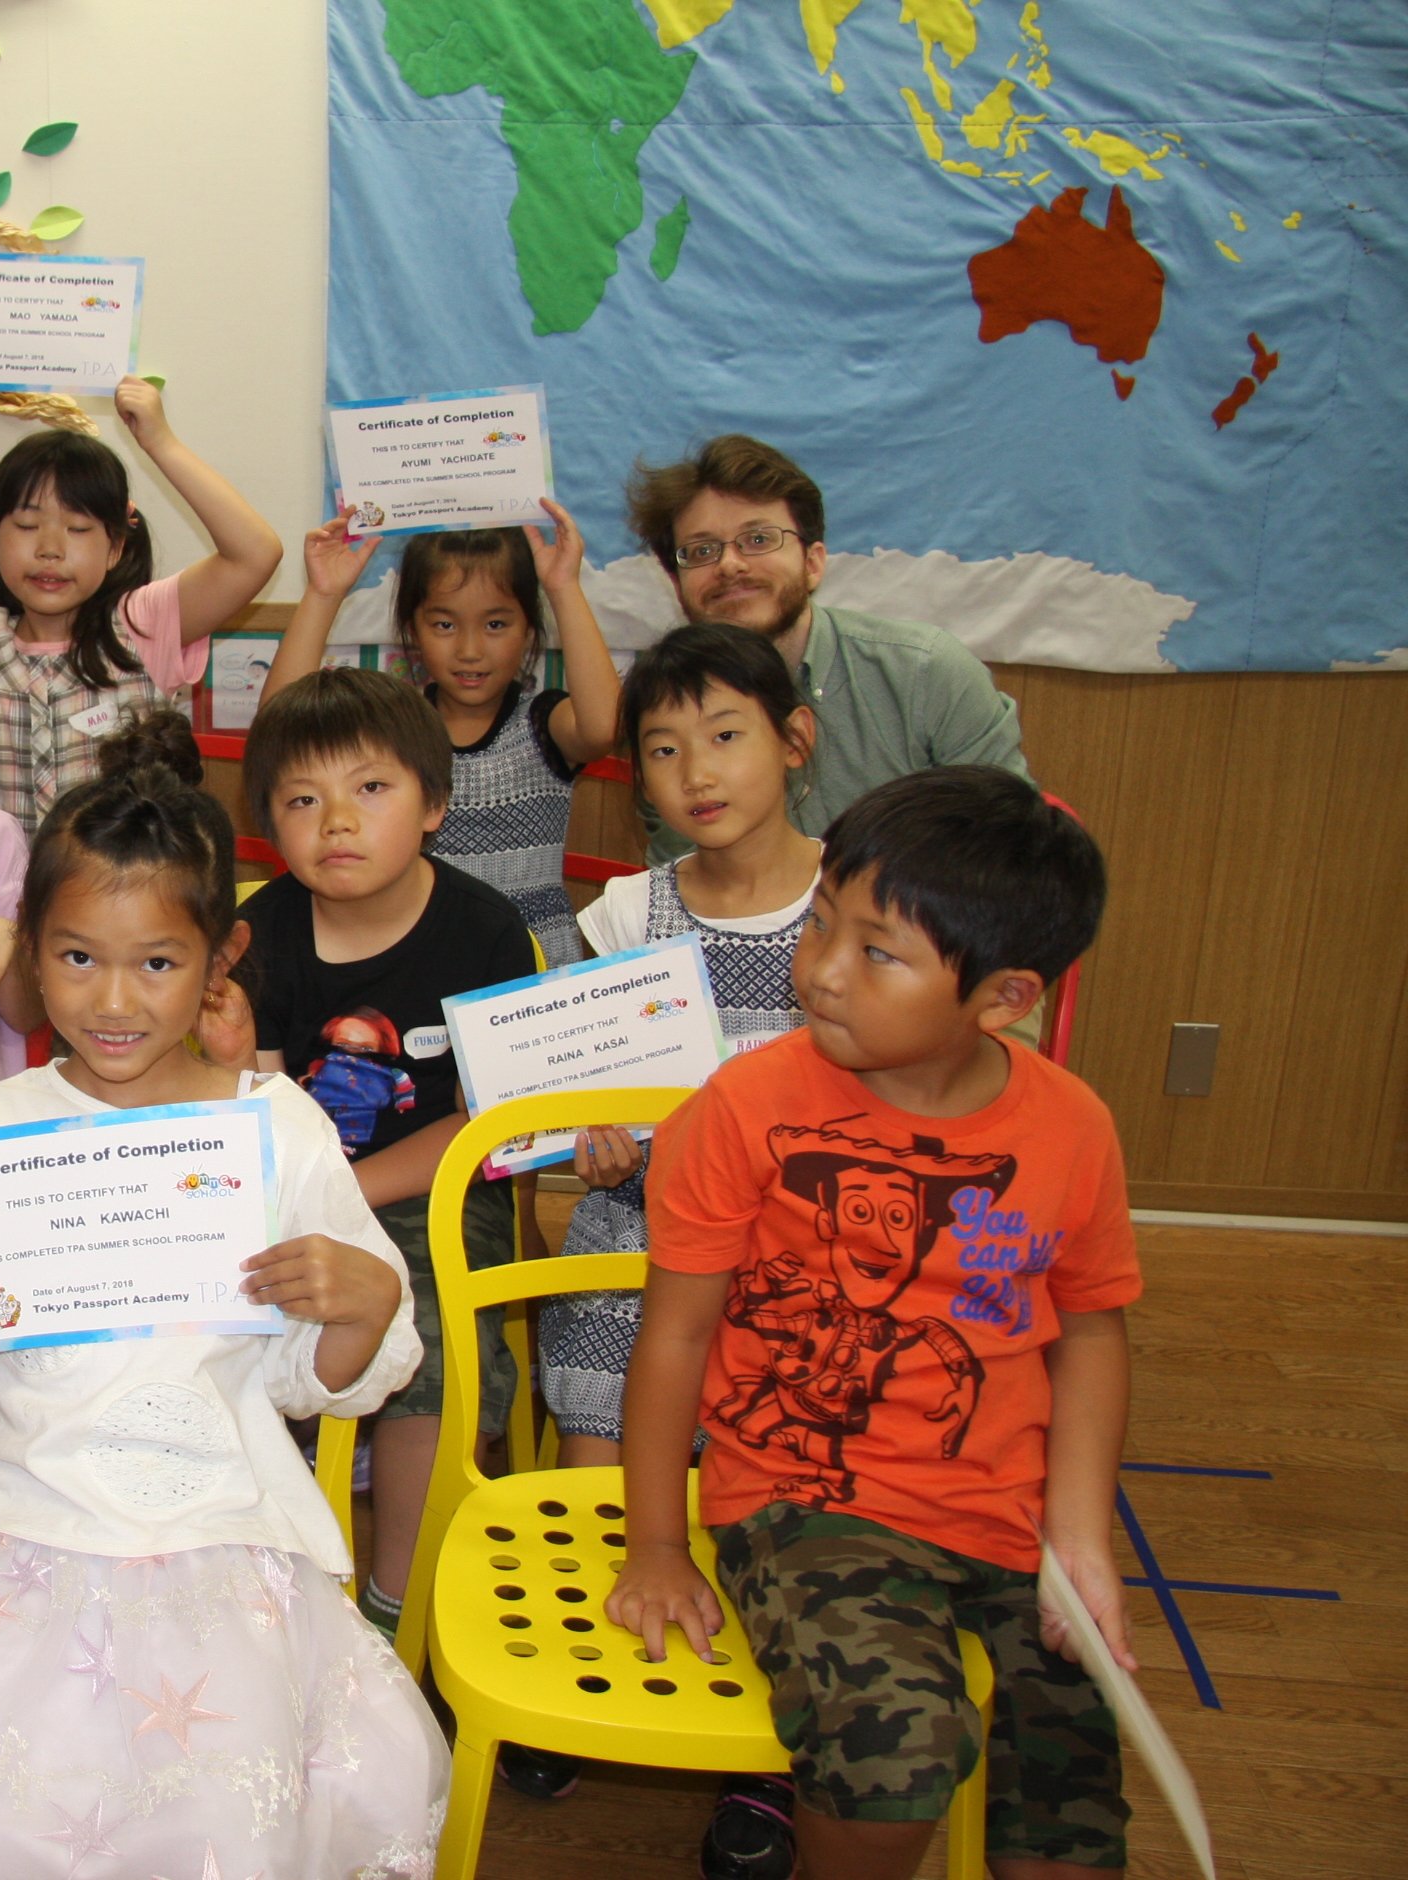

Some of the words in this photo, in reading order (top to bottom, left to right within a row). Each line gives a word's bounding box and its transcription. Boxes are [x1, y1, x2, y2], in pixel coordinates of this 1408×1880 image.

[35, 275, 46, 283] of
[50, 275, 114, 286] Completion
[40, 314, 78, 322] YAMADA
[359, 418, 423, 431] Certificate
[427, 416, 439, 424] of
[444, 409, 514, 424] Completion
[412, 440, 444, 449] CERTIFY
[401, 458, 431, 468] AYUMI
[441, 452, 495, 464] YACHIDATE
[87, 712, 108, 727] MAO
[490, 1000, 567, 1027] Certificate
[572, 992, 586, 1004] of
[591, 970, 671, 999] Completion
[510, 1042, 530, 1052] THIS
[532, 1038, 541, 1046] IS
[543, 1034, 555, 1043] TO
[557, 1024, 594, 1040] CERTIFY
[597, 1016, 619, 1028] THAT
[547, 1049, 584, 1066] RAINA
[594, 1036, 628, 1053] KASAI
[498, 1092, 514, 1100] HAS
[516, 1078, 562, 1096] COMPLETED
[564, 1074, 579, 1083] TPA
[580, 1064, 612, 1078] SUMMER
[614, 1054, 644, 1069] SCHOOL
[646, 1044, 682, 1061] PROGRAM
[93, 1148, 110, 1161] of
[117, 1138, 224, 1158] Completion
[6, 1197, 32, 1209] THIS
[34, 1196, 45, 1205] IS
[49, 1193, 64, 1204] TO
[67, 1187, 116, 1202] CERTIFY
[119, 1183, 148, 1195] THAT
[50, 1216, 85, 1230] NINA
[100, 1208, 169, 1224] KAWACHI
[950, 1187, 1027, 1240] You
[5, 1247, 65, 1262] COMPLETED
[67, 1244, 85, 1253] TPA
[87, 1240, 129, 1251] SUMMER
[132, 1236, 173, 1247] SCHOOL
[175, 1233, 225, 1243] PROGRAM
[32, 1288, 53, 1297] Date
[55, 1285, 65, 1294] of
[67, 1283, 99, 1294] August
[113, 1280, 133, 1288] 2018
[33, 1302, 70, 1315] Tokyo
[73, 1296, 128, 1310] Passport
[133, 1291, 190, 1306] Academy
